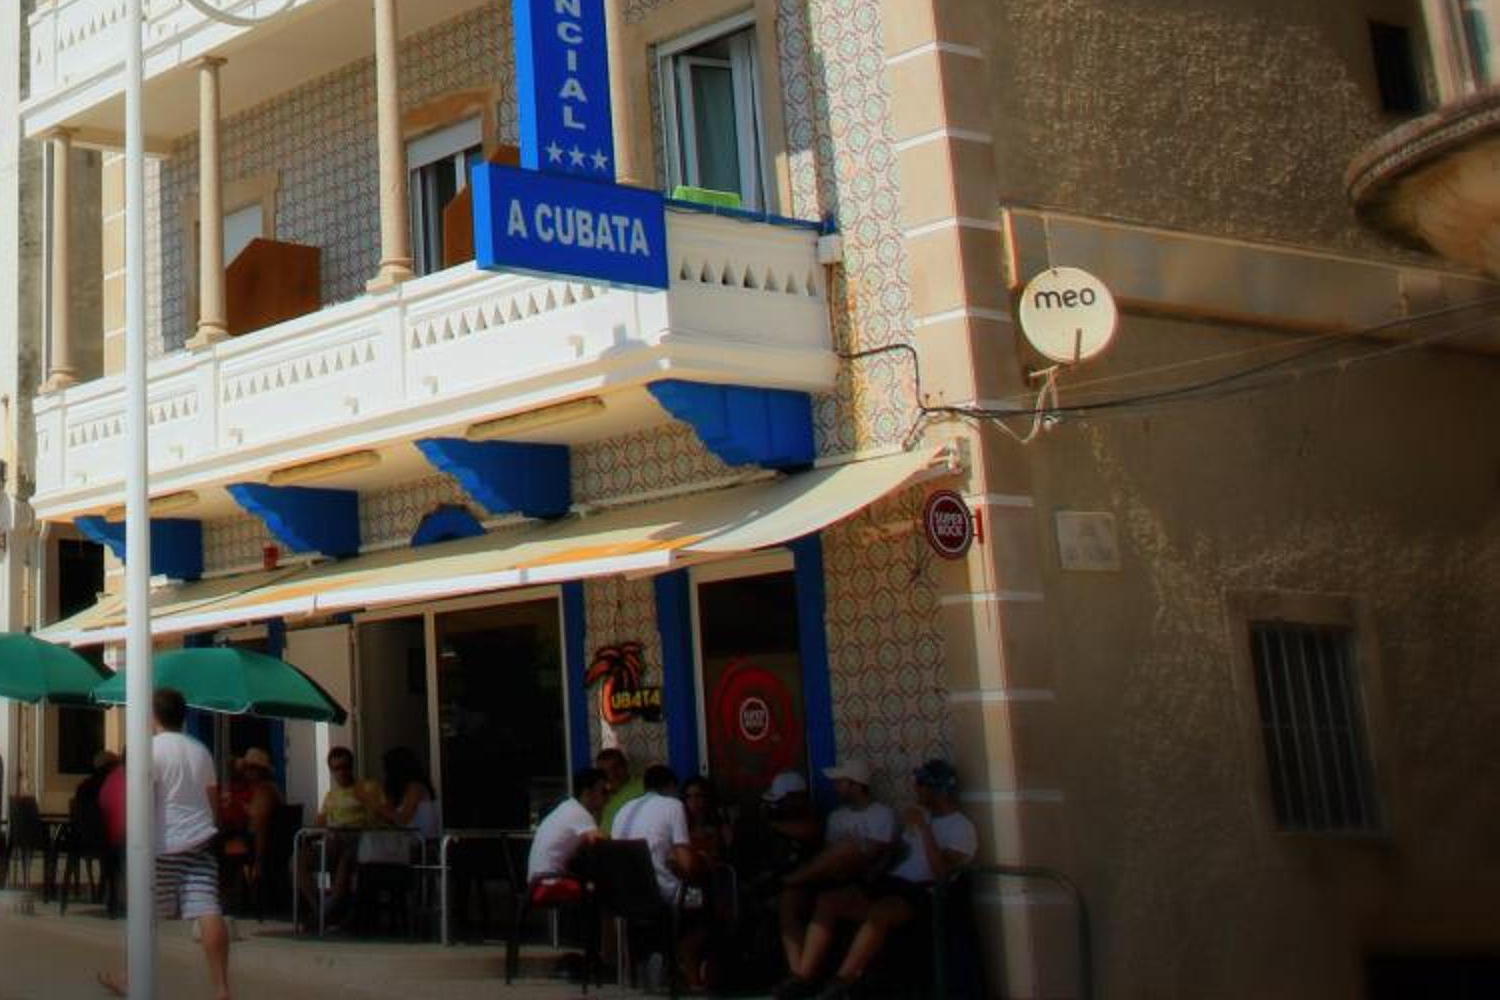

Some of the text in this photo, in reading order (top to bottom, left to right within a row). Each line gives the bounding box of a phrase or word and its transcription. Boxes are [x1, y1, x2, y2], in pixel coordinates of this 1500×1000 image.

[507, 199, 650, 257] A CUBATA
[1034, 286, 1097, 310] meo
